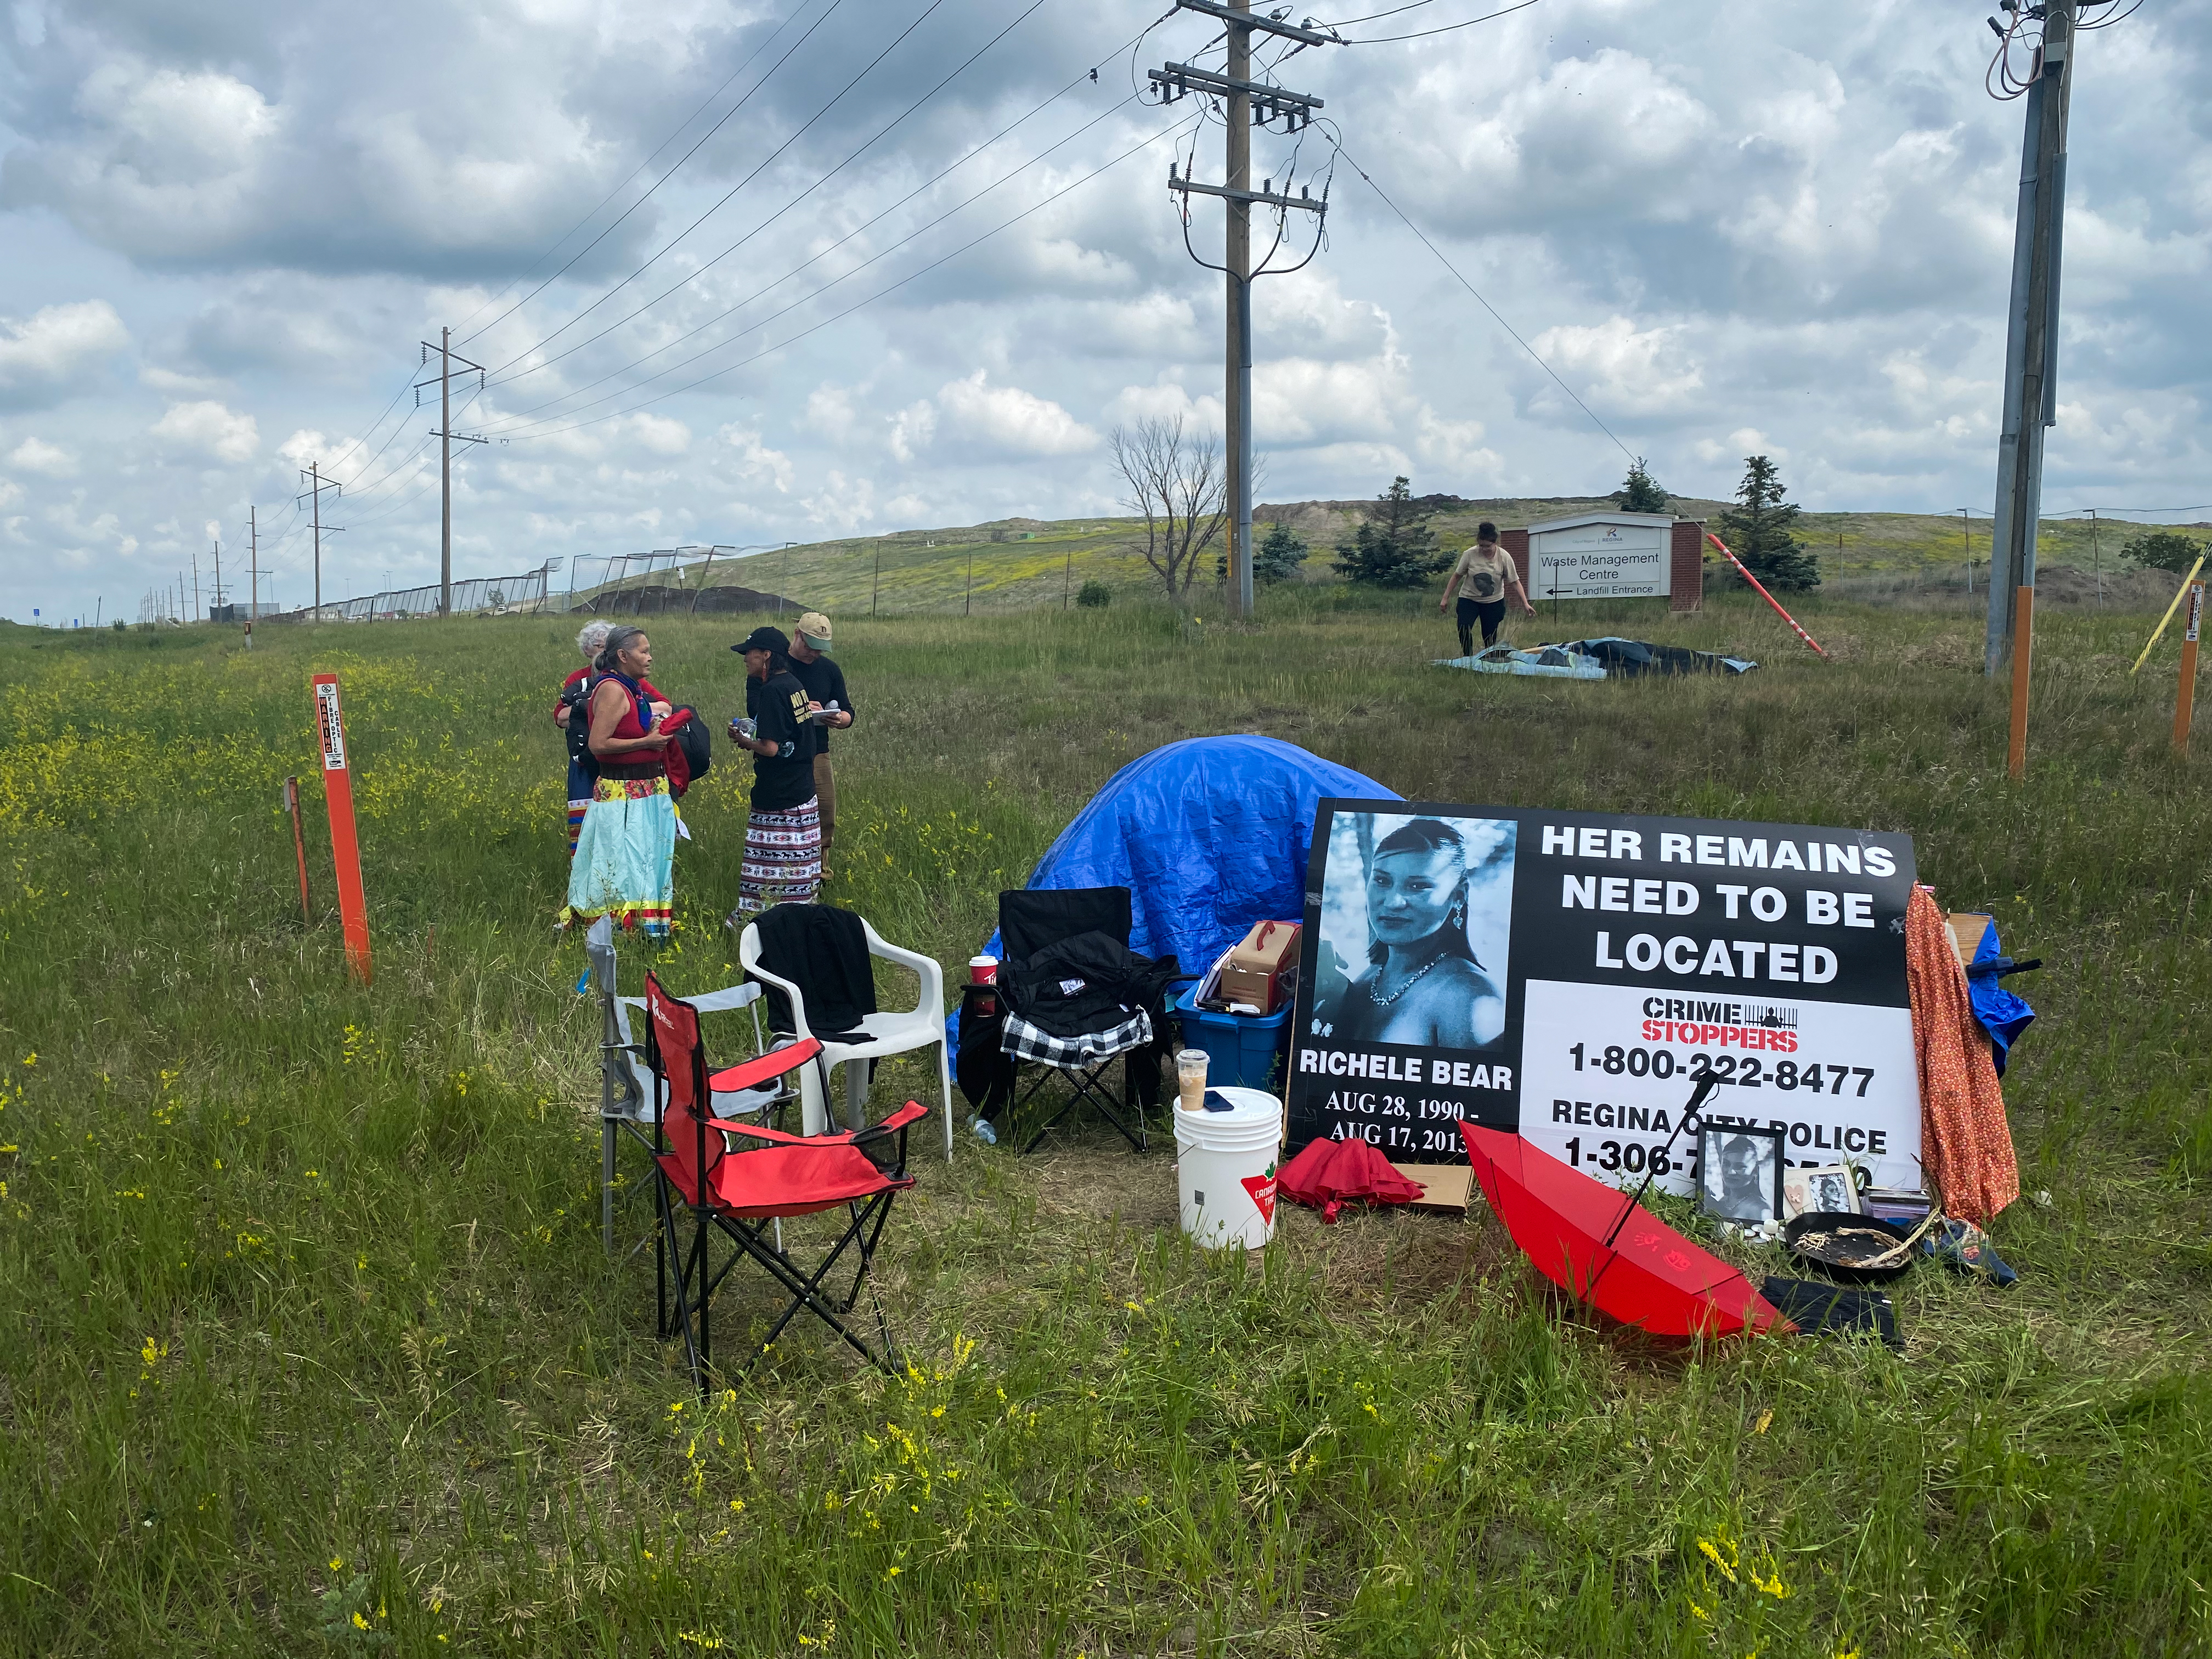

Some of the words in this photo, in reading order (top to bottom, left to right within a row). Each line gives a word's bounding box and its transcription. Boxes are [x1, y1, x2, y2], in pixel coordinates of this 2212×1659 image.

[1541, 556, 1577, 567] Waste
[1581, 552, 1659, 566] Management
[1579, 569, 1618, 580] Centre
[1577, 586, 1609, 595] Landfill
[1612, 585, 1653, 594] Entrance
[319, 697, 331, 752] WARNING
[1541, 825, 1643, 860] HER
[1660, 832, 1896, 877] REMAINS
[1562, 874, 1700, 916] NEED
[1716, 884, 1787, 922] TO
[1806, 890, 1875, 928] BE
[1595, 931, 1838, 984] LOCATED
[1643, 997, 1741, 1025] CRIME
[1642, 1019, 1798, 1053] STOPPERS
[1300, 1049, 1422, 1082] RICHELE
[1432, 1060, 1512, 1091] BEAR
[1570, 1042, 1875, 1097] 1-800-222-8477
[1325, 1090, 1376, 1113] AUG
[1381, 1095, 1410, 1121] 28,
[1418, 1099, 1464, 1121] 1990
[1553, 1099, 1672, 1133] REGINA
[1329, 1121, 1381, 1144] AUG
[1389, 1126, 1416, 1152] 17,
[1264, 1193, 1274, 1206] TIRE
